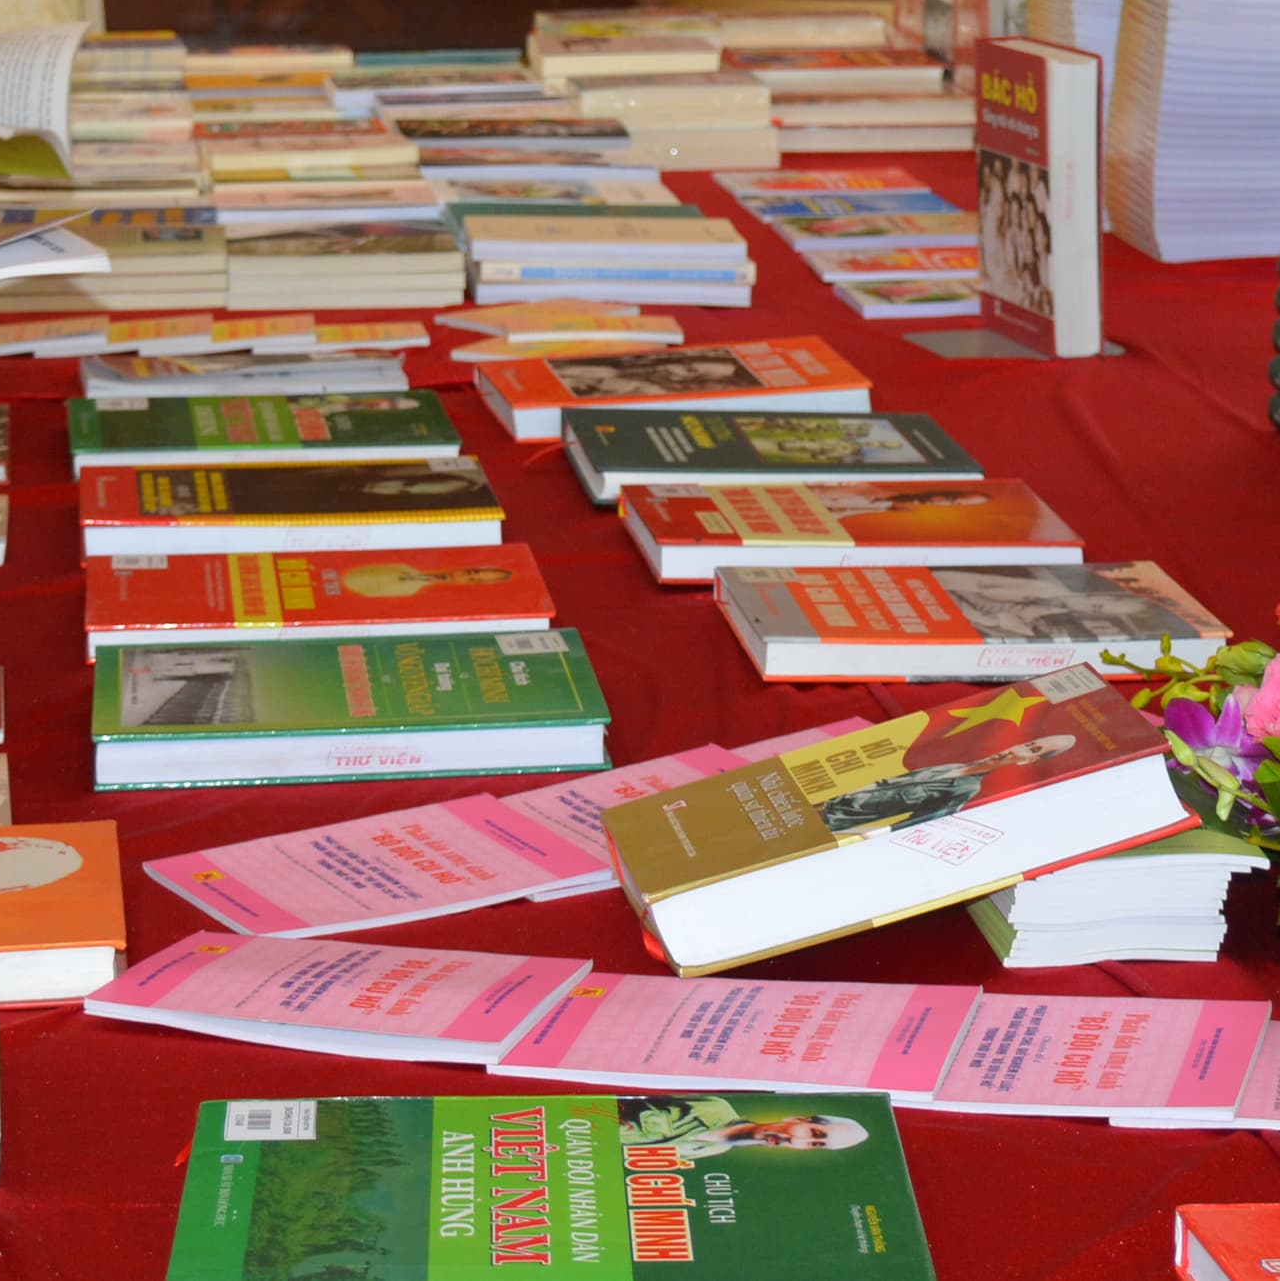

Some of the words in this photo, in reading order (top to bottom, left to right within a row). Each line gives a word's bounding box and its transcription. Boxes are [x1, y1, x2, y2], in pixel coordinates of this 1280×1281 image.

[981, 69, 1012, 107] BÁC
[1014, 71, 1038, 114] HỒ
[825, 749, 874, 775] CHÍ
[860, 737, 907, 759] HỒ
[790, 759, 838, 795] MINH
[1063, 1032, 1103, 1051] ĐỘI
[1054, 1053, 1092, 1069] CỤ
[442, 1130, 475, 1174] ANH
[483, 1105, 560, 1182] VIỆT
[559, 1118, 598, 1157] QUÂN
[568, 1156, 601, 1186] ĐỘI
[623, 1144, 695, 1171] HỒ
[626, 1172, 697, 1207] CHÍ
[704, 1172, 739, 1196] CHỦ
[439, 1177, 482, 1238] HÙNG
[569, 1188, 603, 1230] NHÂN
[708, 1197, 737, 1223] TỊCH
[491, 1185, 552, 1266] NAM
[629, 1208, 694, 1262] MINH
[572, 1232, 606, 1263] DÂN
